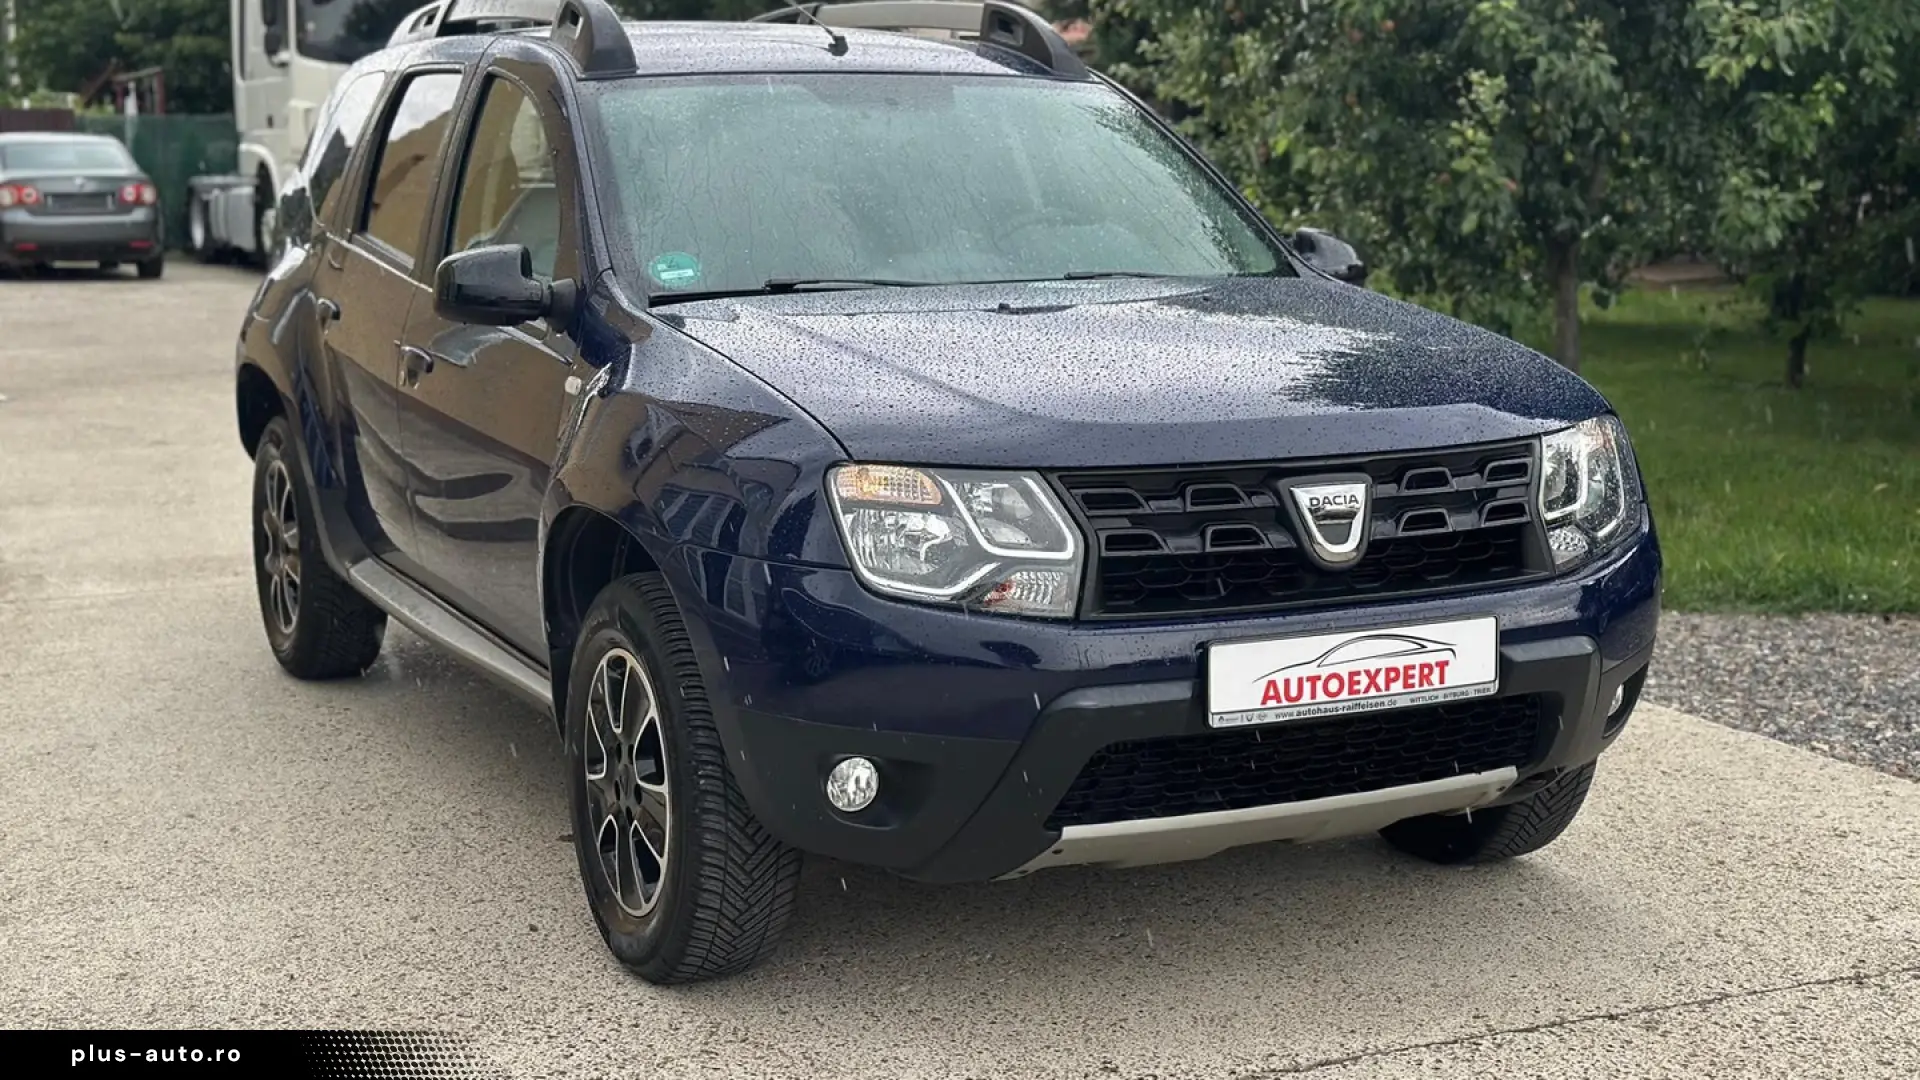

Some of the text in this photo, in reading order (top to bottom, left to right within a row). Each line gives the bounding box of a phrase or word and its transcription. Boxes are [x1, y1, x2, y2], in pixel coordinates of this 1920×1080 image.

[1309, 494, 1359, 507] DACIA
[1260, 660, 1450, 705] AUTOEXPERT
[1275, 698, 1398, 720] www.autohaus-raiffeisen.de
